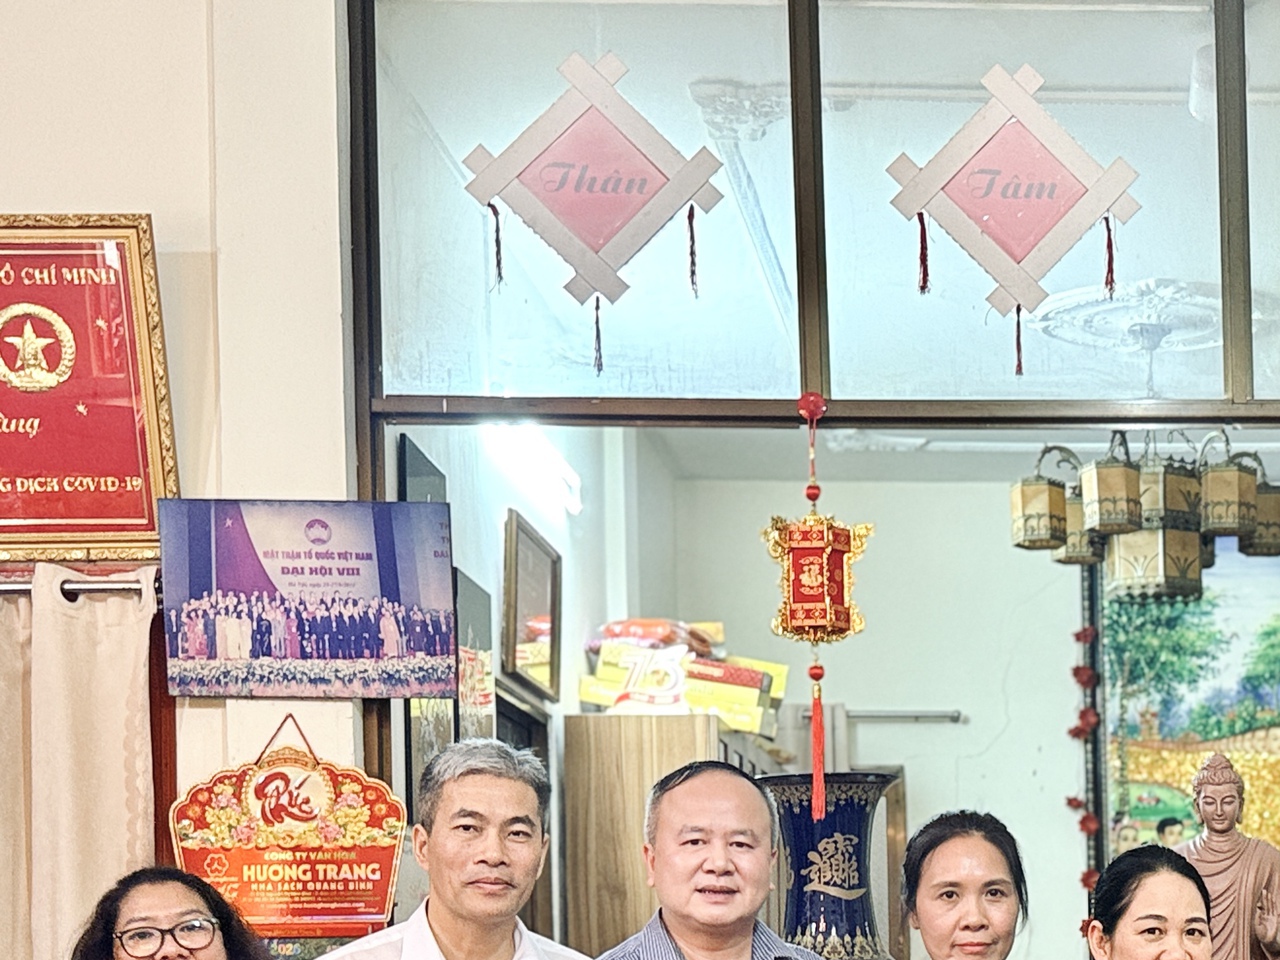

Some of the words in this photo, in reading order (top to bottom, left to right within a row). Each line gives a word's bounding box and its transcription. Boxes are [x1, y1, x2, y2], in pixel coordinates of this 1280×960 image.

[539, 162, 651, 196] Thân
[967, 168, 1058, 201] Tâm
[21, 263, 57, 286] CHÍ
[61, 267, 117, 286] MINH
[15, 477, 59, 495] DỊCH
[63, 476, 143, 492] COVID-19
[355, 552, 373, 561] NAM
[281, 566, 306, 577] ĐẠI
[308, 565, 334, 578] HỘI
[336, 567, 361, 577] VIII
[295, 851, 308, 861] TY
[315, 863, 381, 881] TRANG
